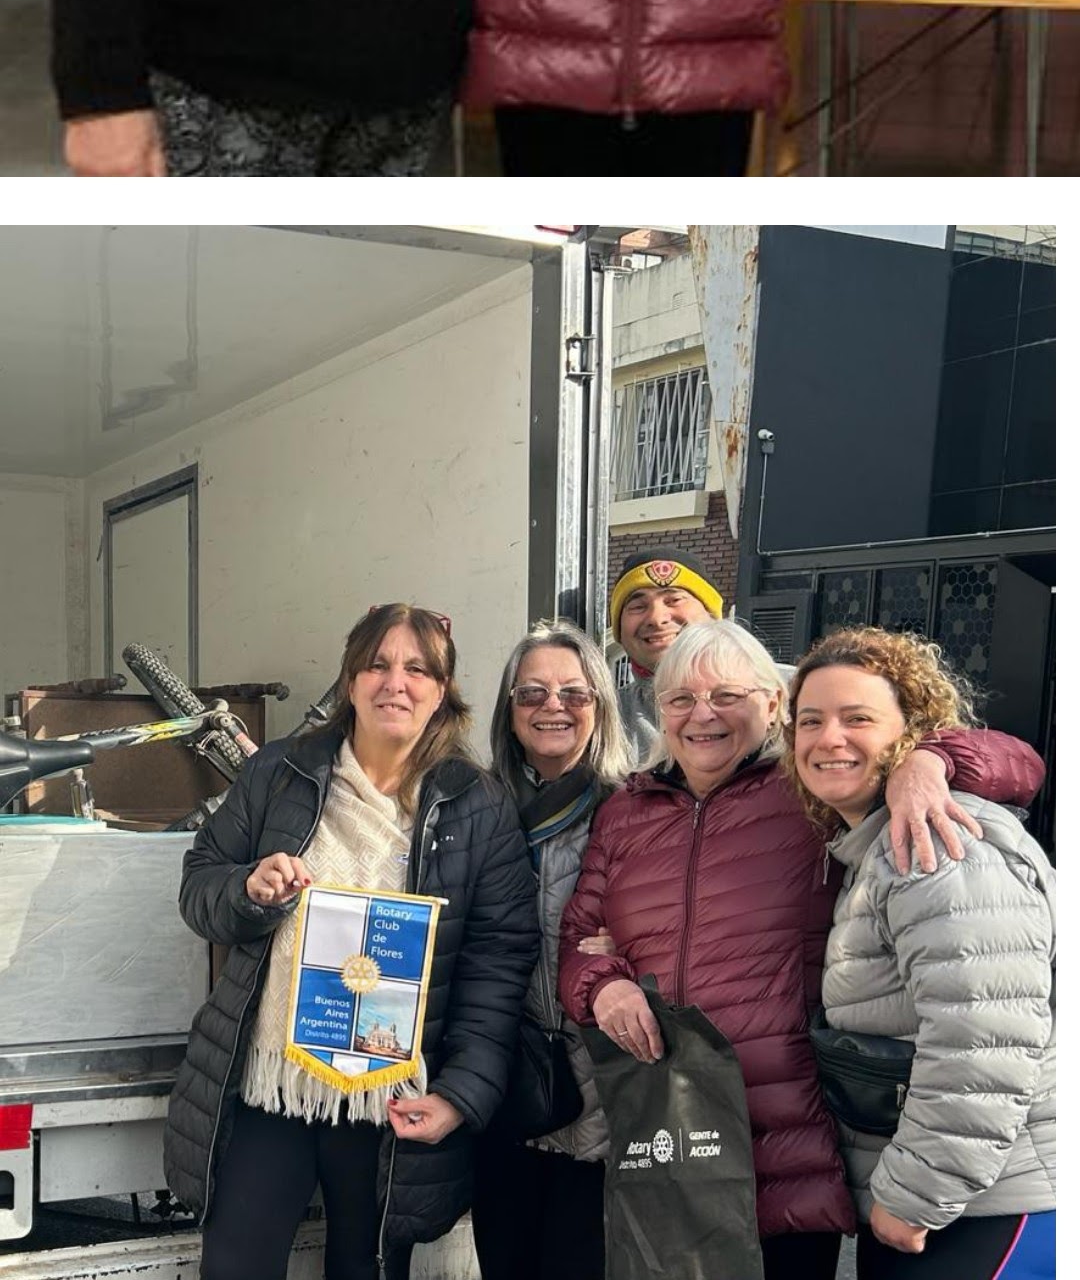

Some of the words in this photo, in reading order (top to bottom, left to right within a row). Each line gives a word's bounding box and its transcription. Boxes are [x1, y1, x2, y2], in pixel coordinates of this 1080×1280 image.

[376, 905, 412, 921] Rotary
[374, 919, 400, 931] Club
[372, 932, 387, 943] de
[371, 946, 403, 960] Flores
[315, 995, 350, 1008] Buenos
[325, 1009, 349, 1019] Aires
[300, 1016, 348, 1030] Argentina
[689, 1131, 711, 1140] GENTE
[711, 1129, 720, 1139] de
[689, 1142, 721, 1157] ACCIÓN
